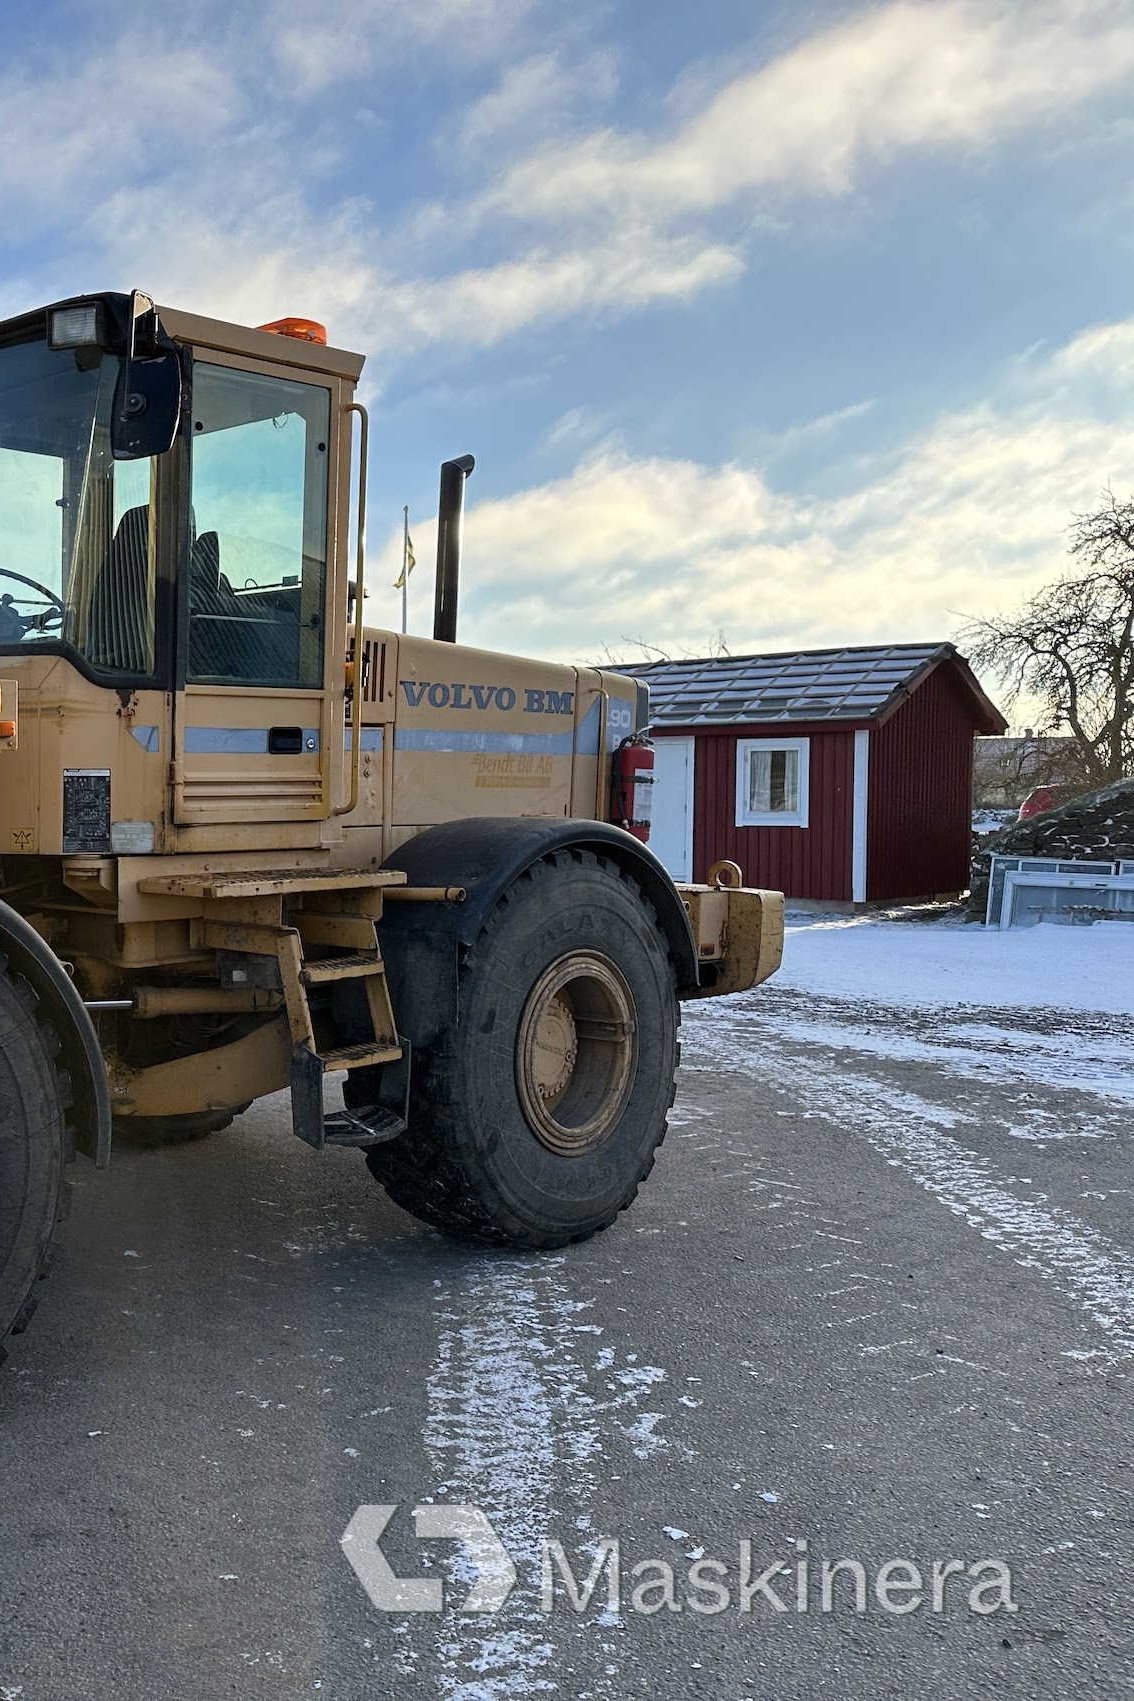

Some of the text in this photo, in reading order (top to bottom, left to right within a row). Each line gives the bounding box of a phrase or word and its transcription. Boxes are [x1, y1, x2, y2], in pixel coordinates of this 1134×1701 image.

[400, 681, 574, 714] VOLVO BM
[607, 709, 631, 728] 90
[477, 754, 554, 774] Bendt Bil AB
